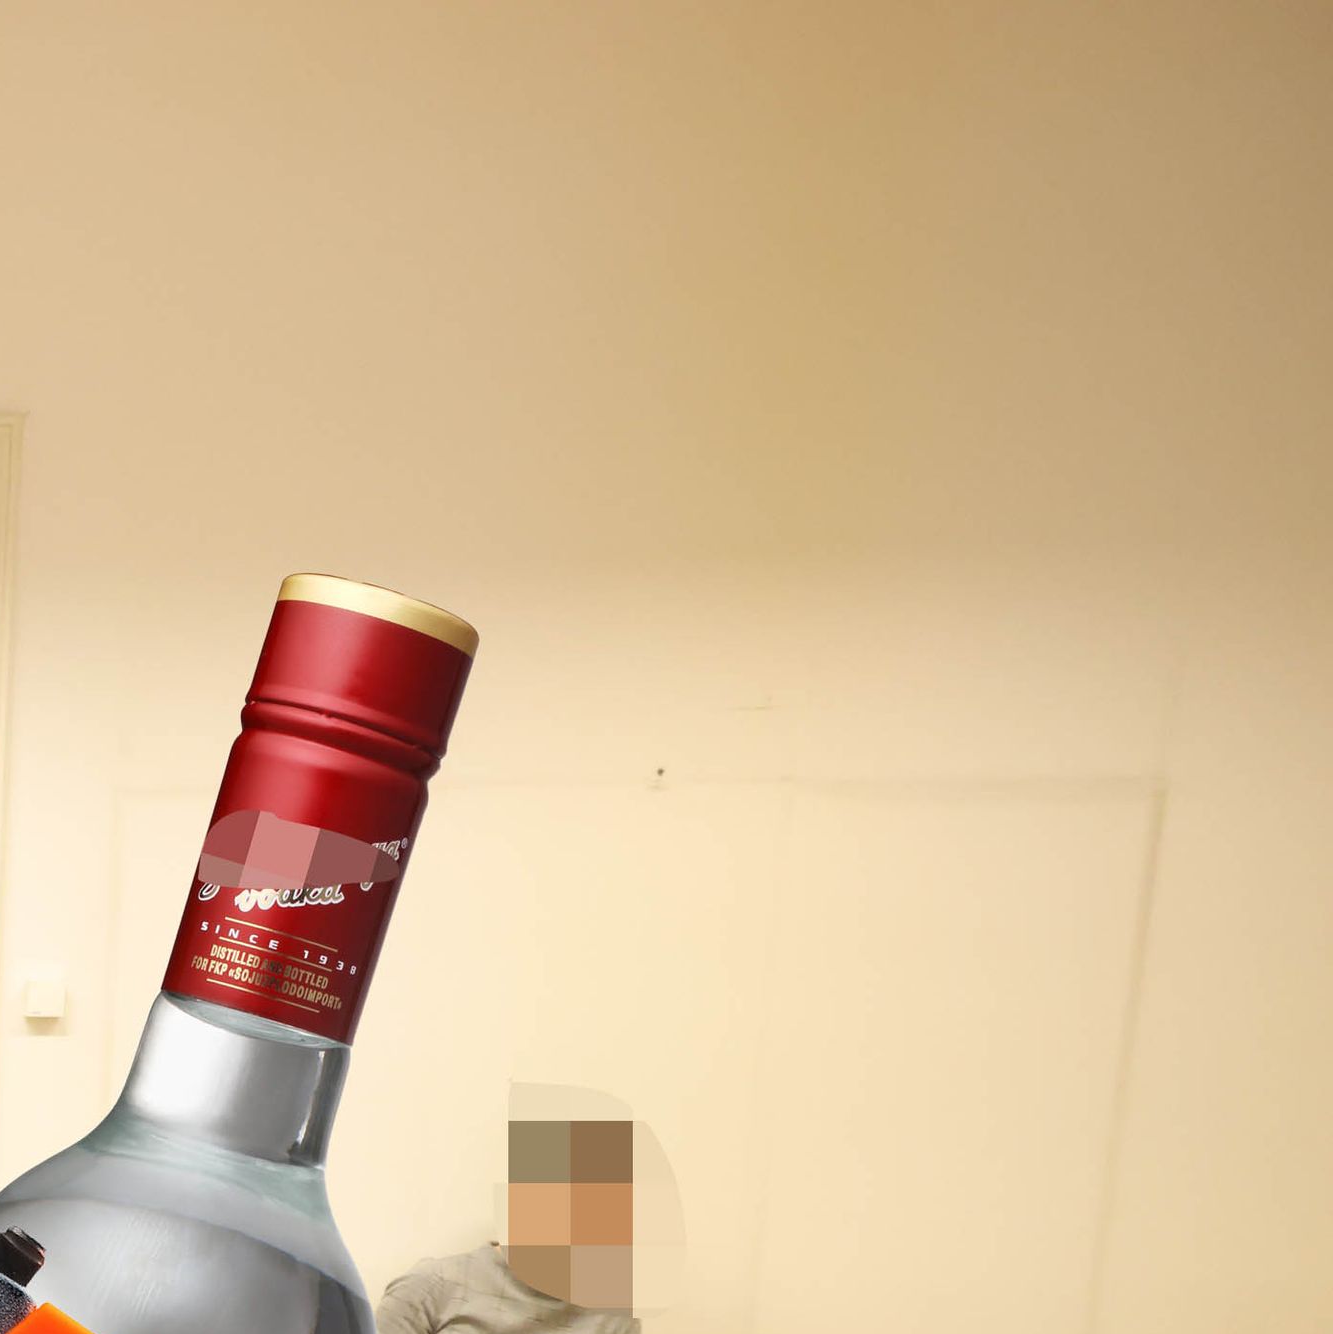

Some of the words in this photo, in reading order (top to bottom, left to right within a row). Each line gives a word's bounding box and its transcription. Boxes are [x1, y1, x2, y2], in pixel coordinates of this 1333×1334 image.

[191, 955, 207, 971] FOR
[208, 960, 229, 978] FKP
[200, 921, 280, 950] SINCE
[303, 950, 357, 975] 1938
[210, 944, 261, 969] DISTILLED
[284, 965, 329, 989] BOTTLED
